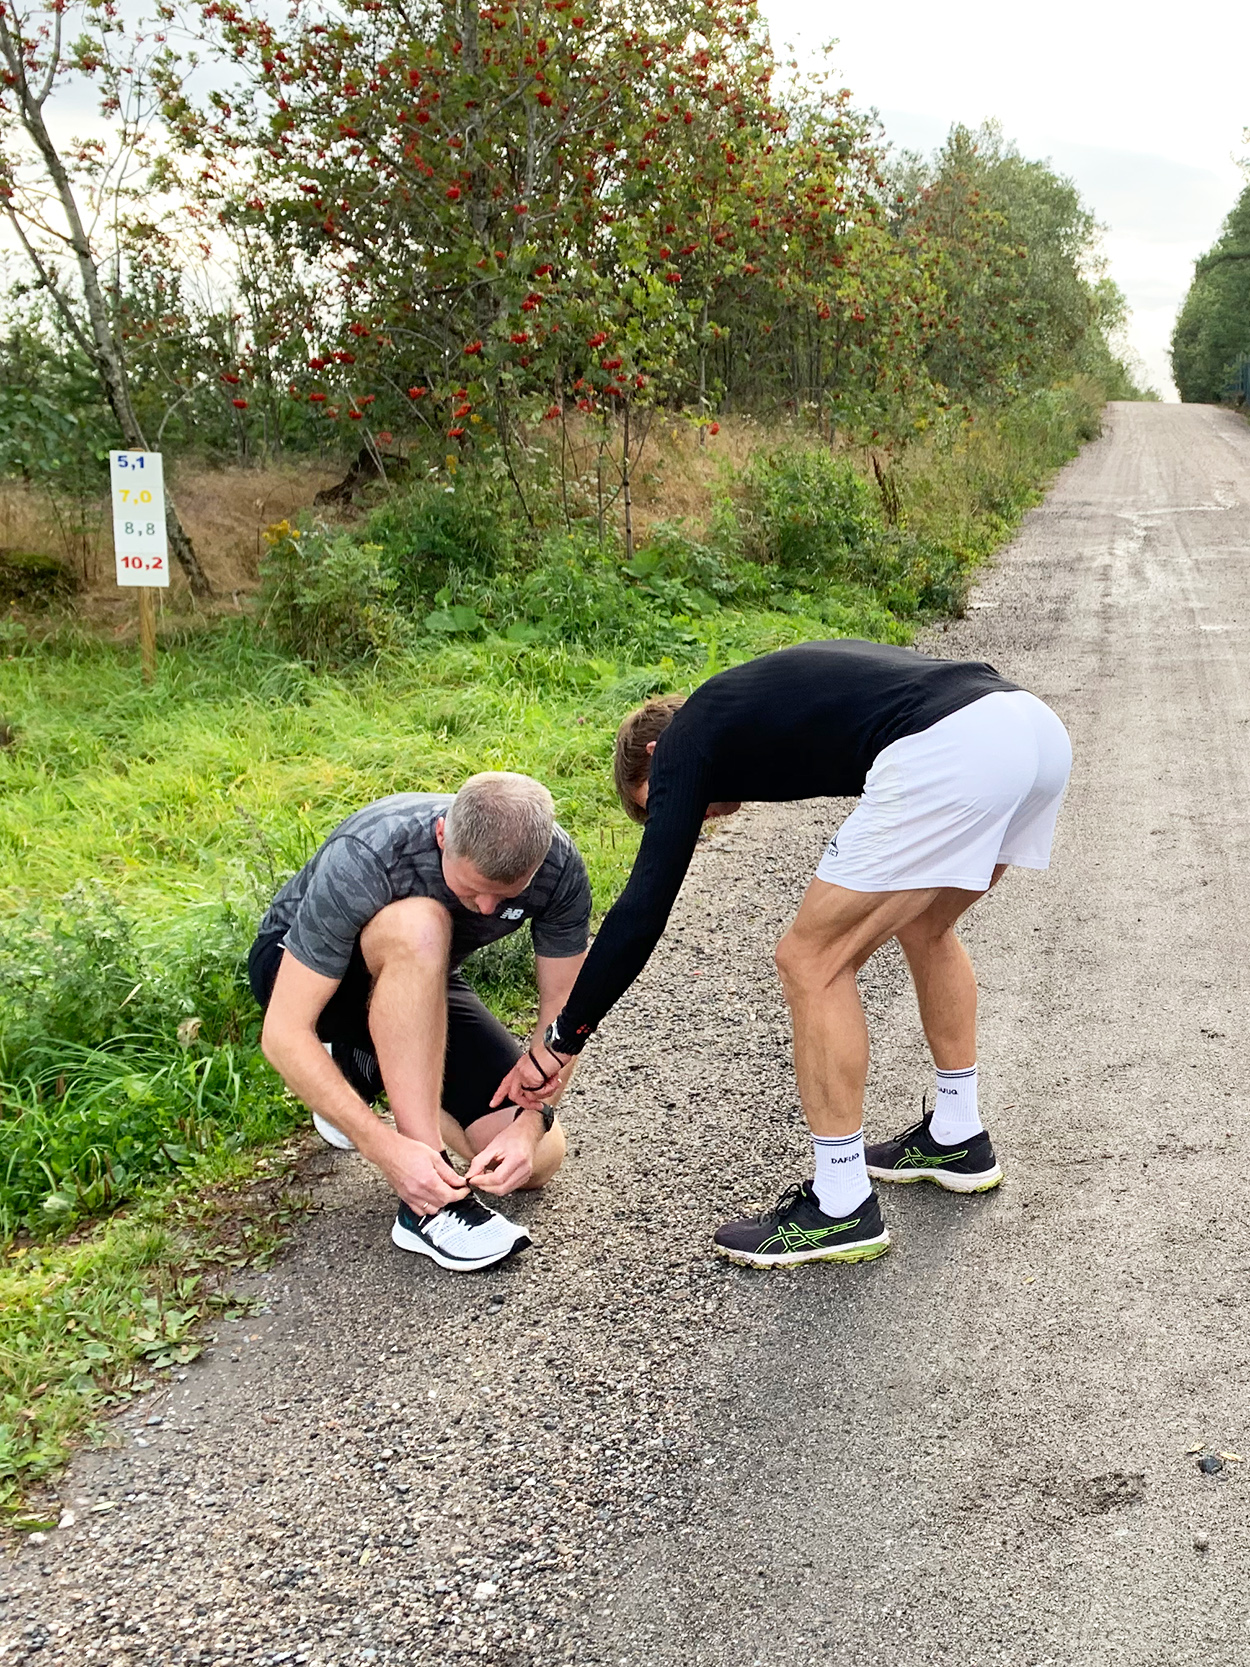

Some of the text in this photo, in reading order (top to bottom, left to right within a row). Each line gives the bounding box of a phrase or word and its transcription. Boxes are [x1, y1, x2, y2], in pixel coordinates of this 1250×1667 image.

[117, 455, 145, 470] 5,1
[118, 489, 152, 505] 7,0
[124, 521, 156, 537] 8,8
[120, 556, 163, 571] 10,2
